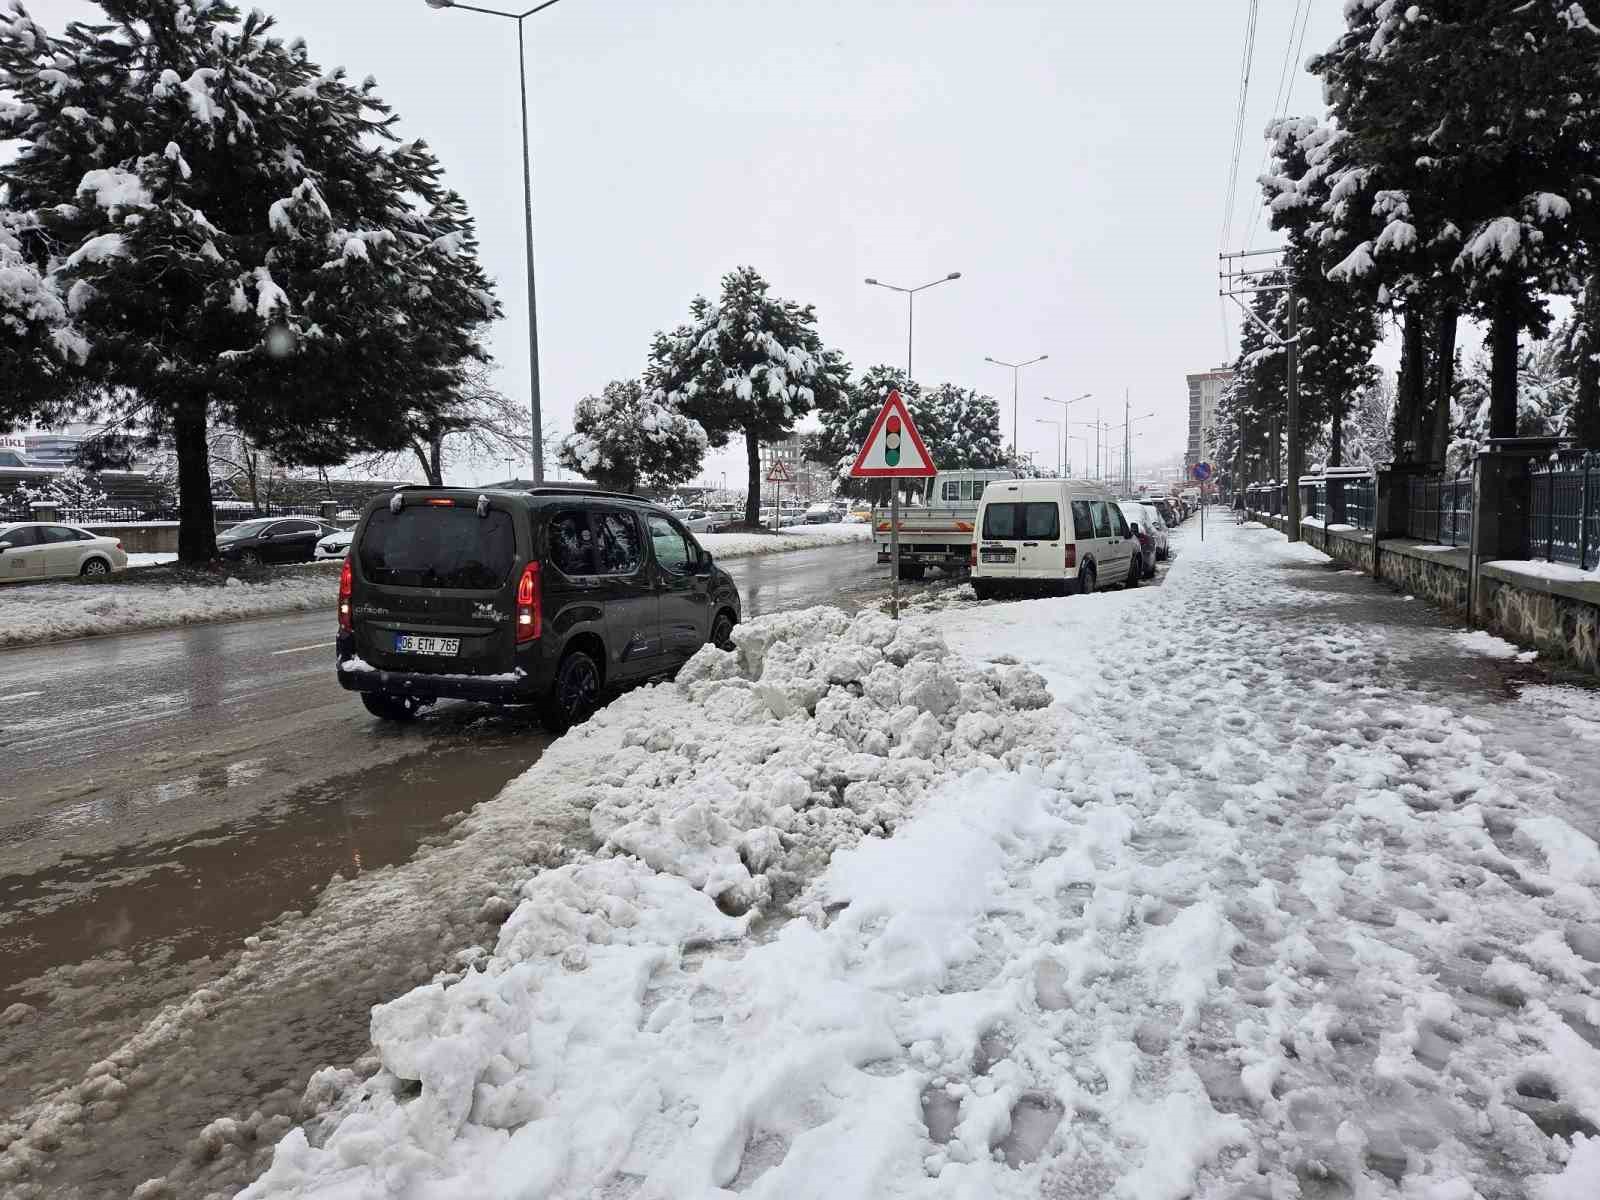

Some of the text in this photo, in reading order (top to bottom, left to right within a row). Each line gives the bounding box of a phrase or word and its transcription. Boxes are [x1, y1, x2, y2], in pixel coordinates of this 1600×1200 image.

[402, 638, 458, 652] 06 ETH 765
